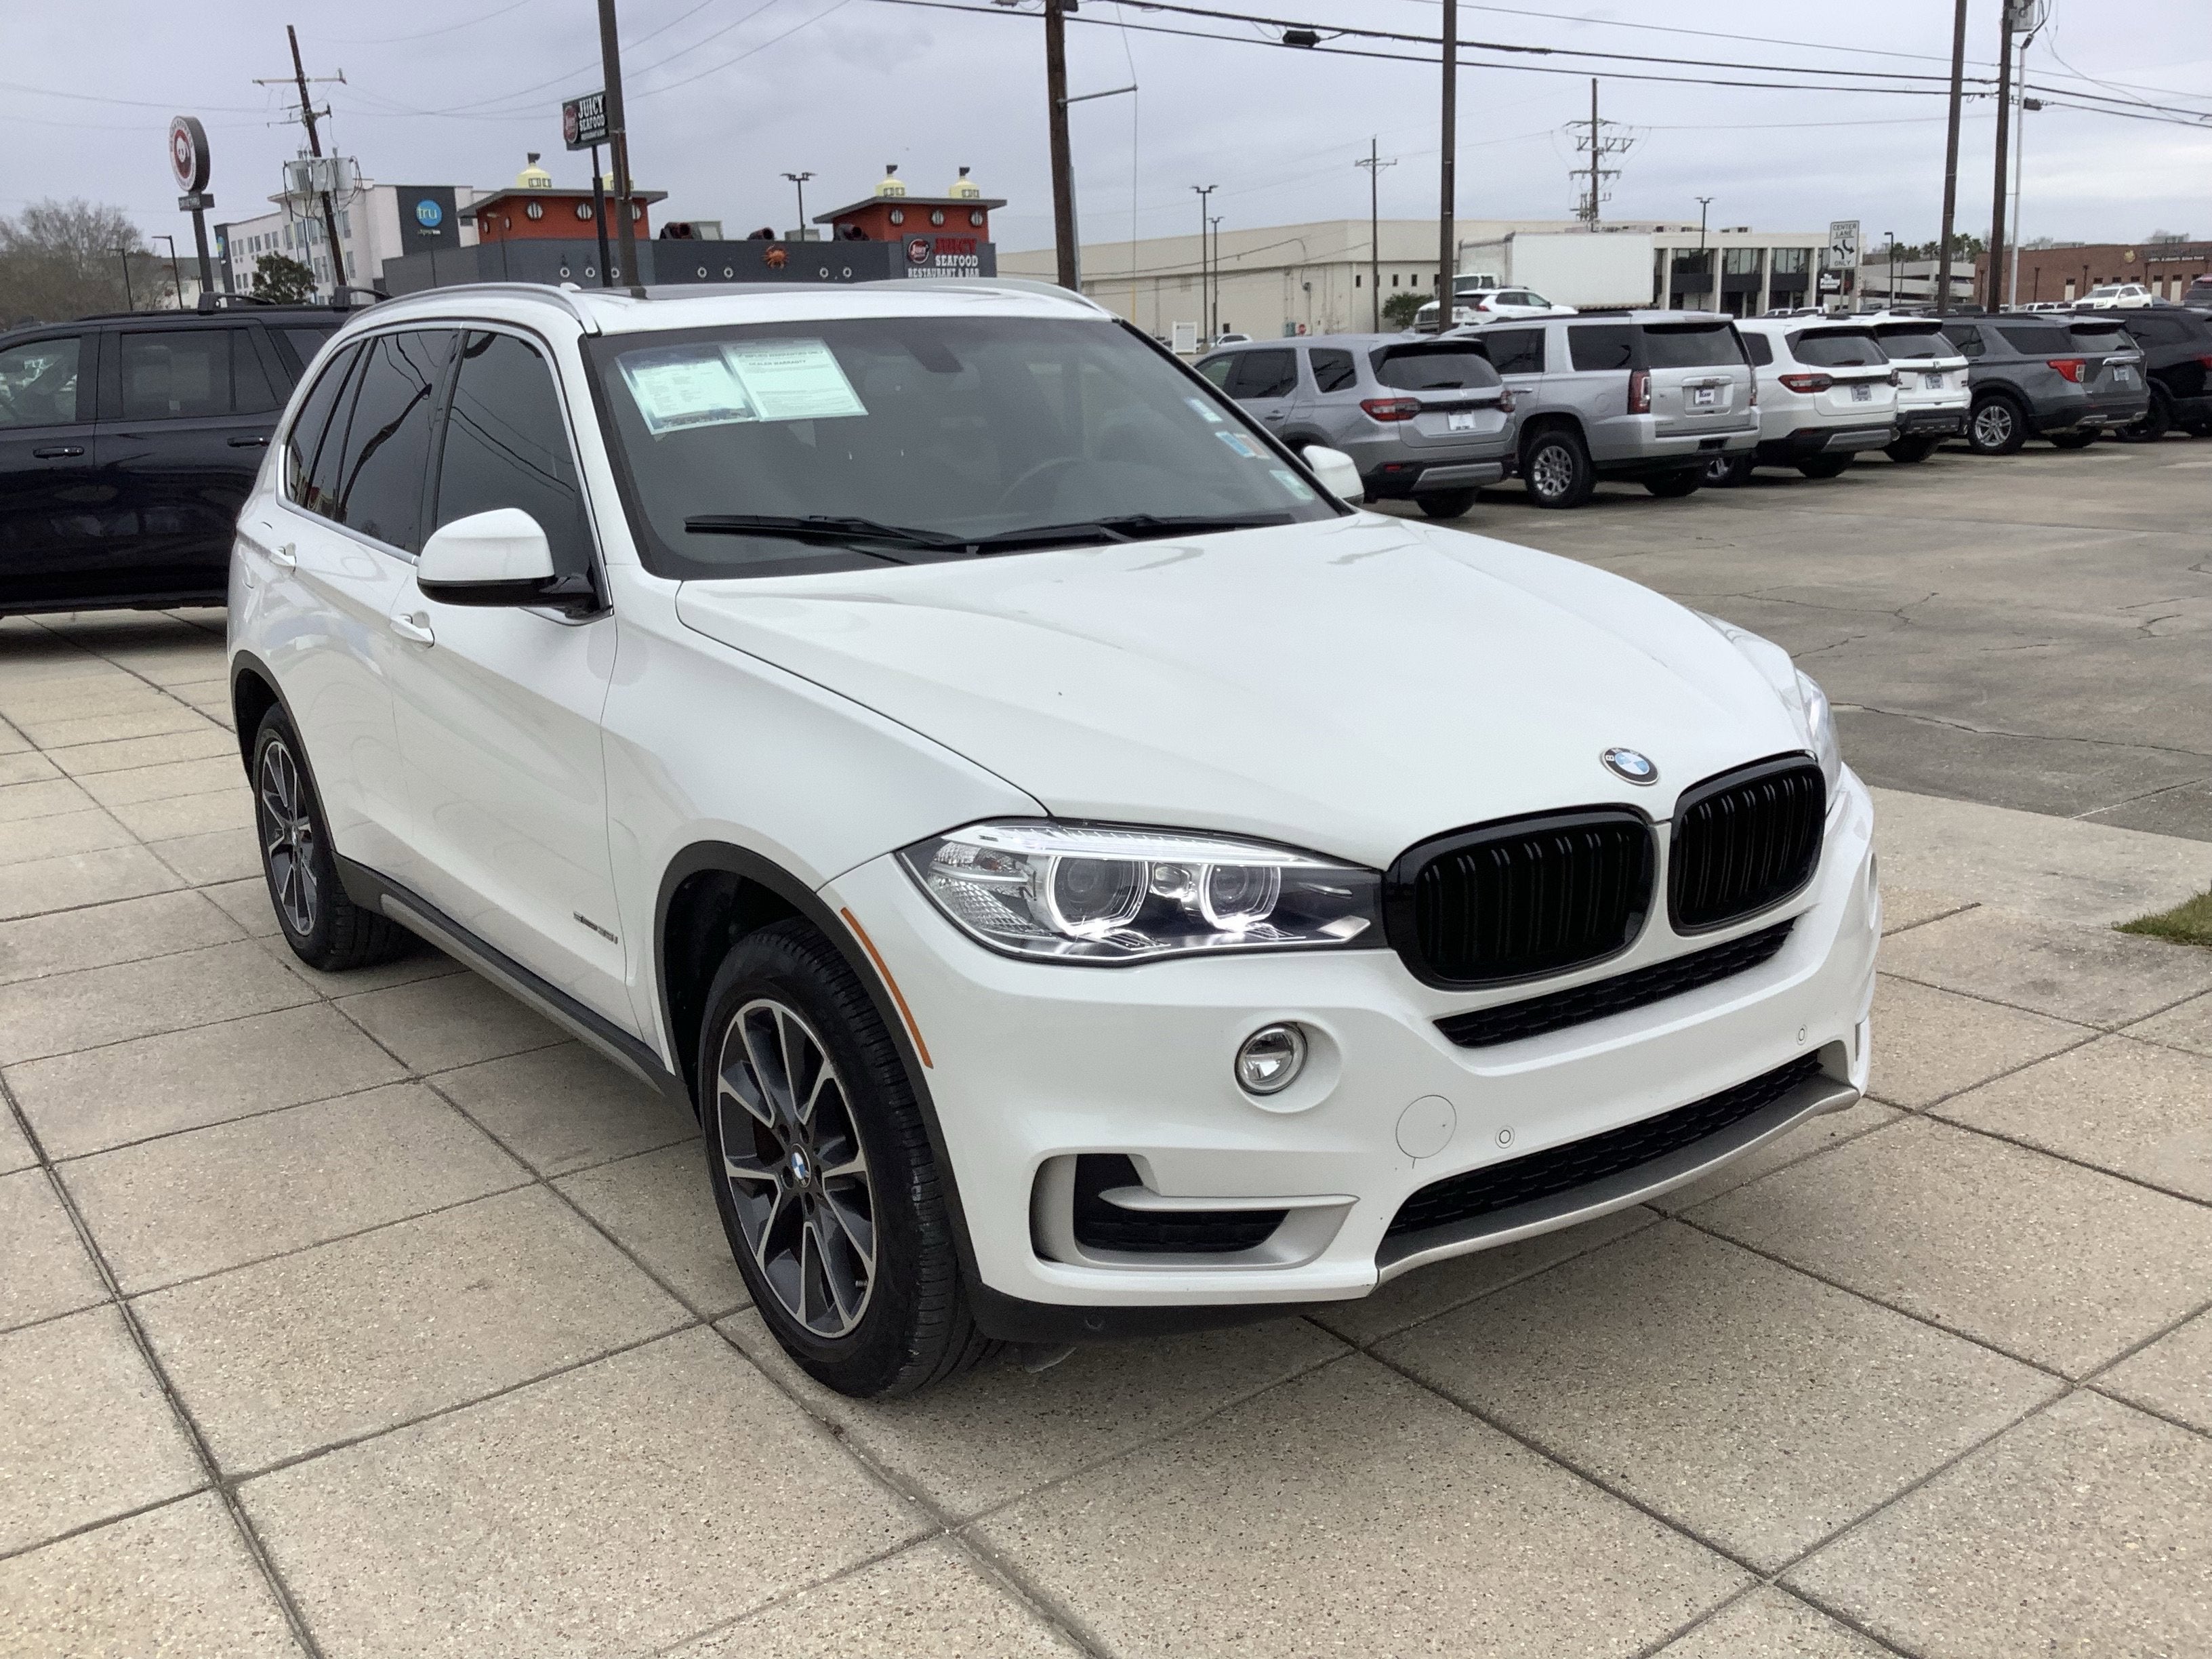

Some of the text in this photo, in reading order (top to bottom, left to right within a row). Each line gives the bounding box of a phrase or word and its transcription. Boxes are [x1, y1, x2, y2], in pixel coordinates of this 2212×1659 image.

[578, 95, 602, 118] JUICY
[579, 114, 605, 131] SEAFOOD
[416, 206, 437, 220] tru
[935, 255, 979, 266] SEAFOOD
[908, 268, 956, 278] RESTAURANT
[965, 268, 979, 278] BAR
